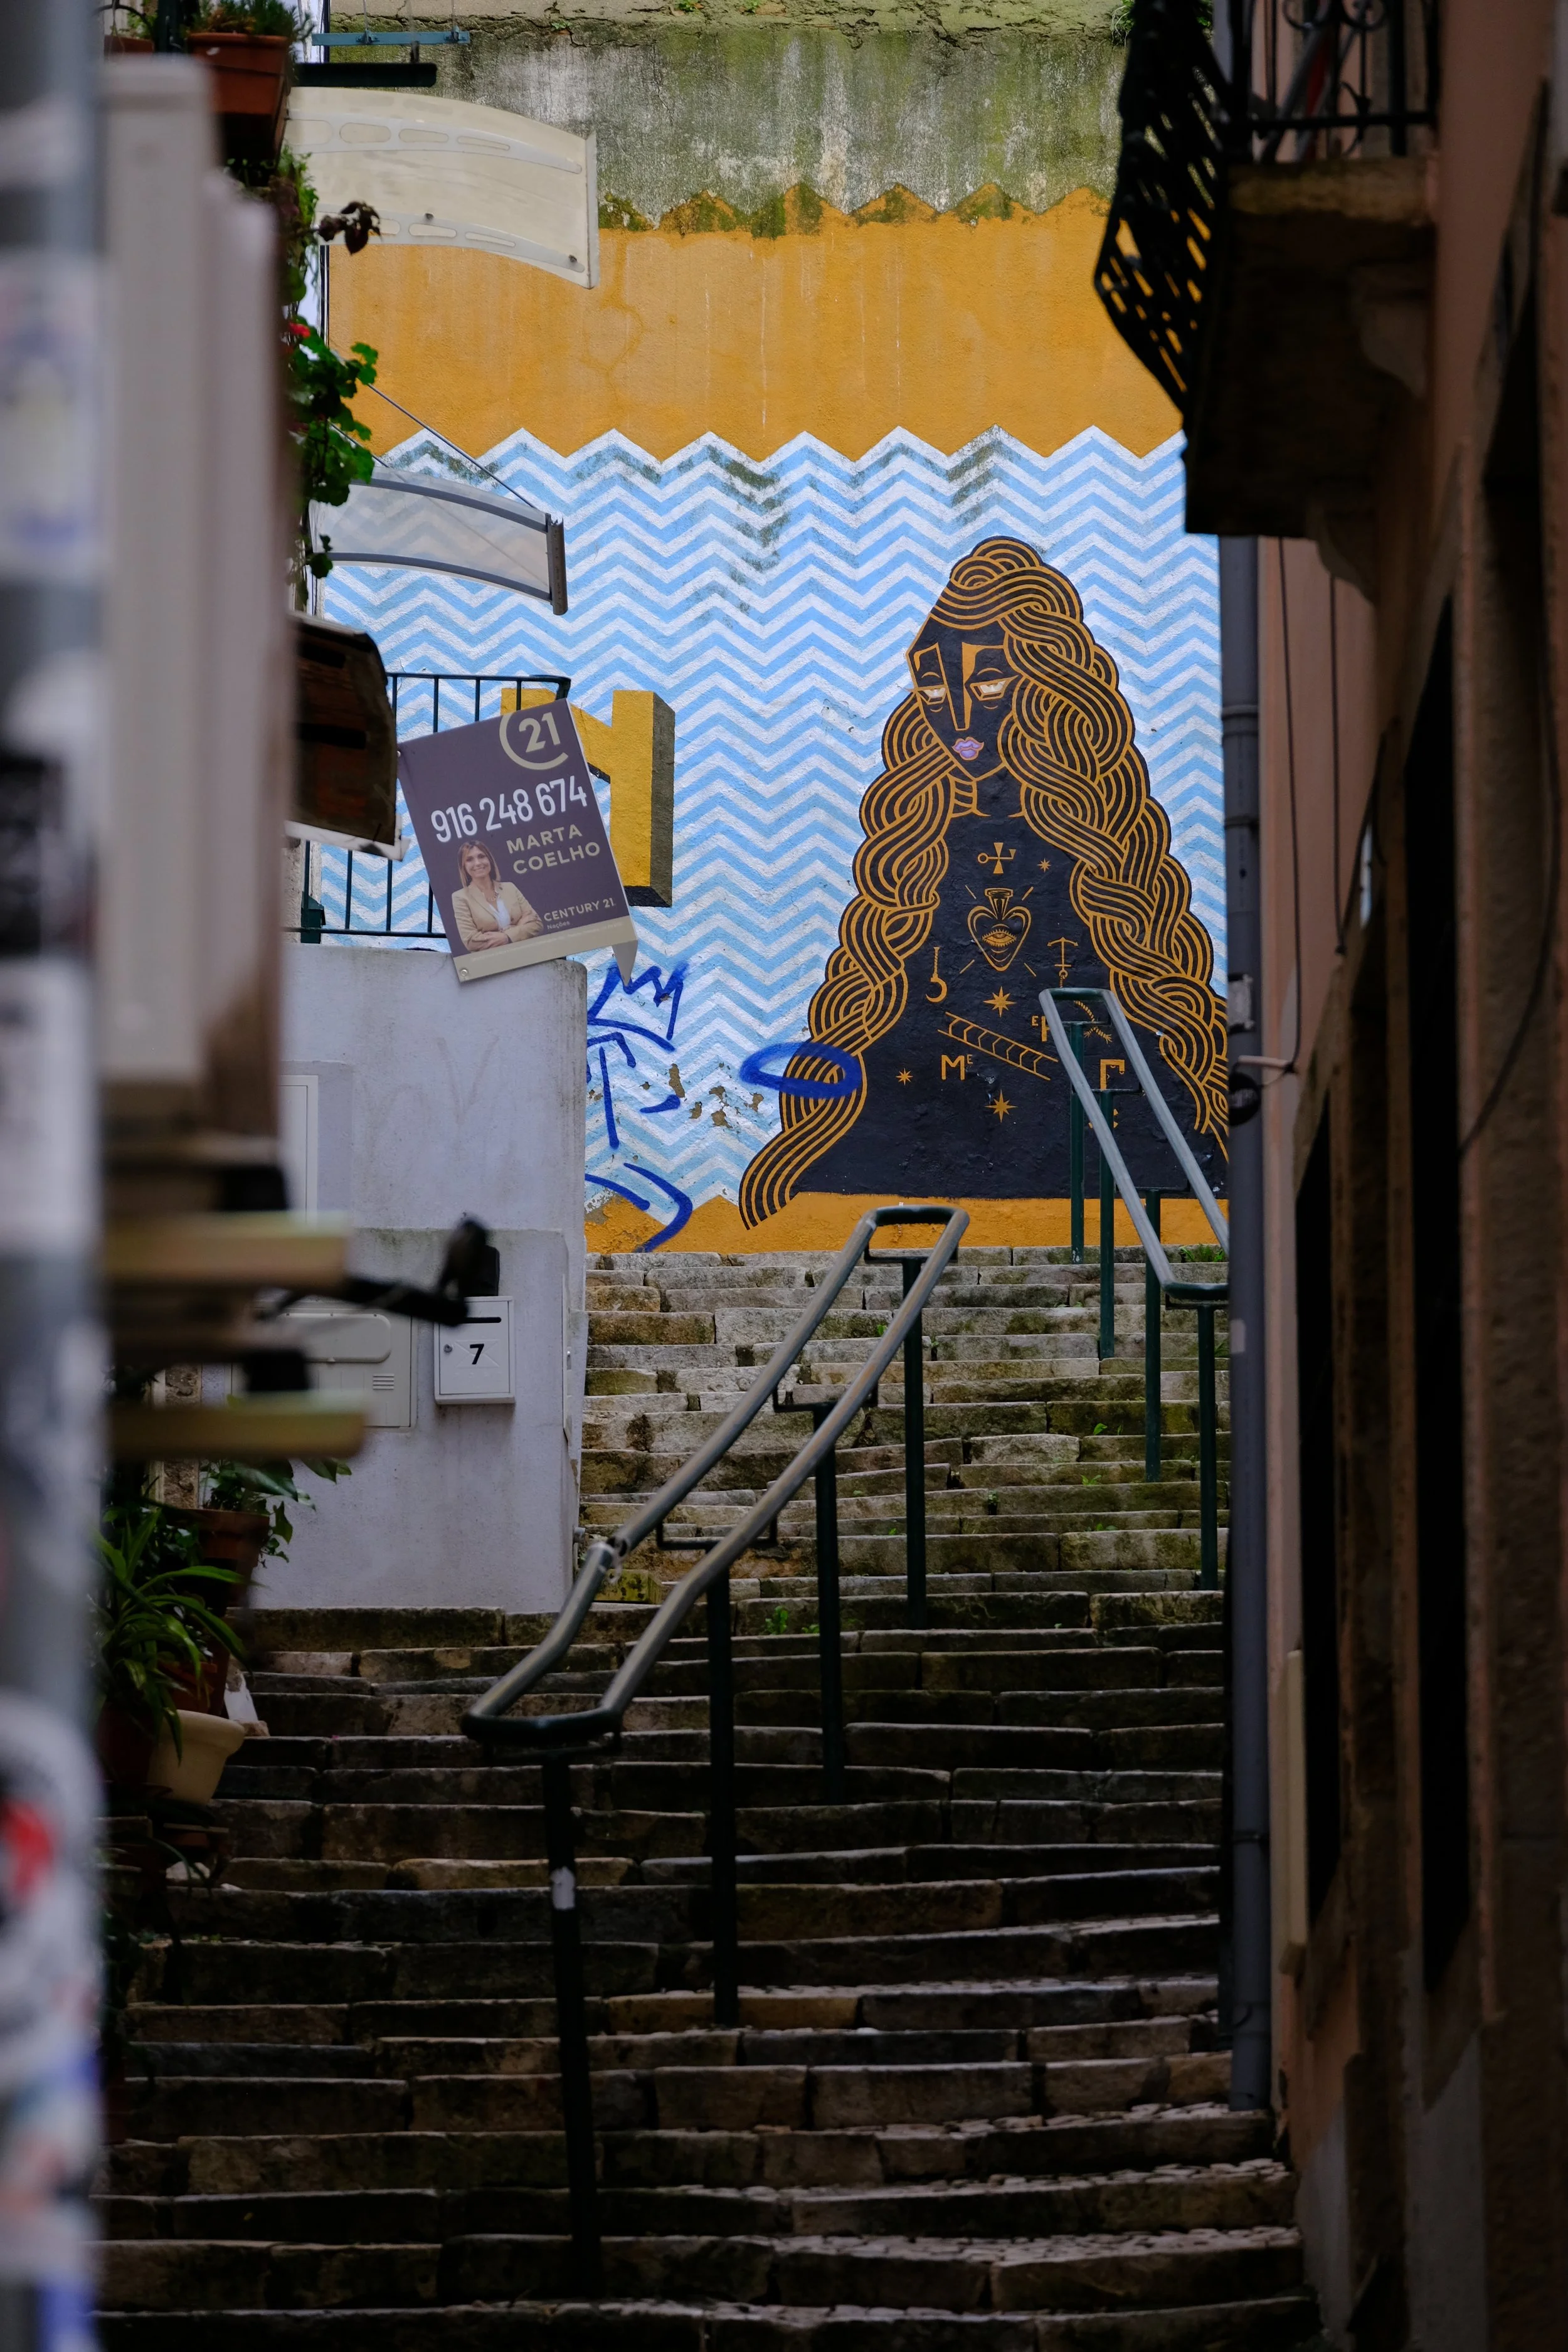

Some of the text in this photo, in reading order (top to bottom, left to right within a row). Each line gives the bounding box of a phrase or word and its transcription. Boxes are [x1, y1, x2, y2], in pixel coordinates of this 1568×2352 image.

[519, 712, 561, 753] 21
[431, 775, 588, 843] 916 248 674
[506, 824, 583, 854] MARTA
[513, 842, 600, 874] COELHO
[544, 898, 615, 922] CENTURY 21
[469, 1343, 485, 1365] 7
